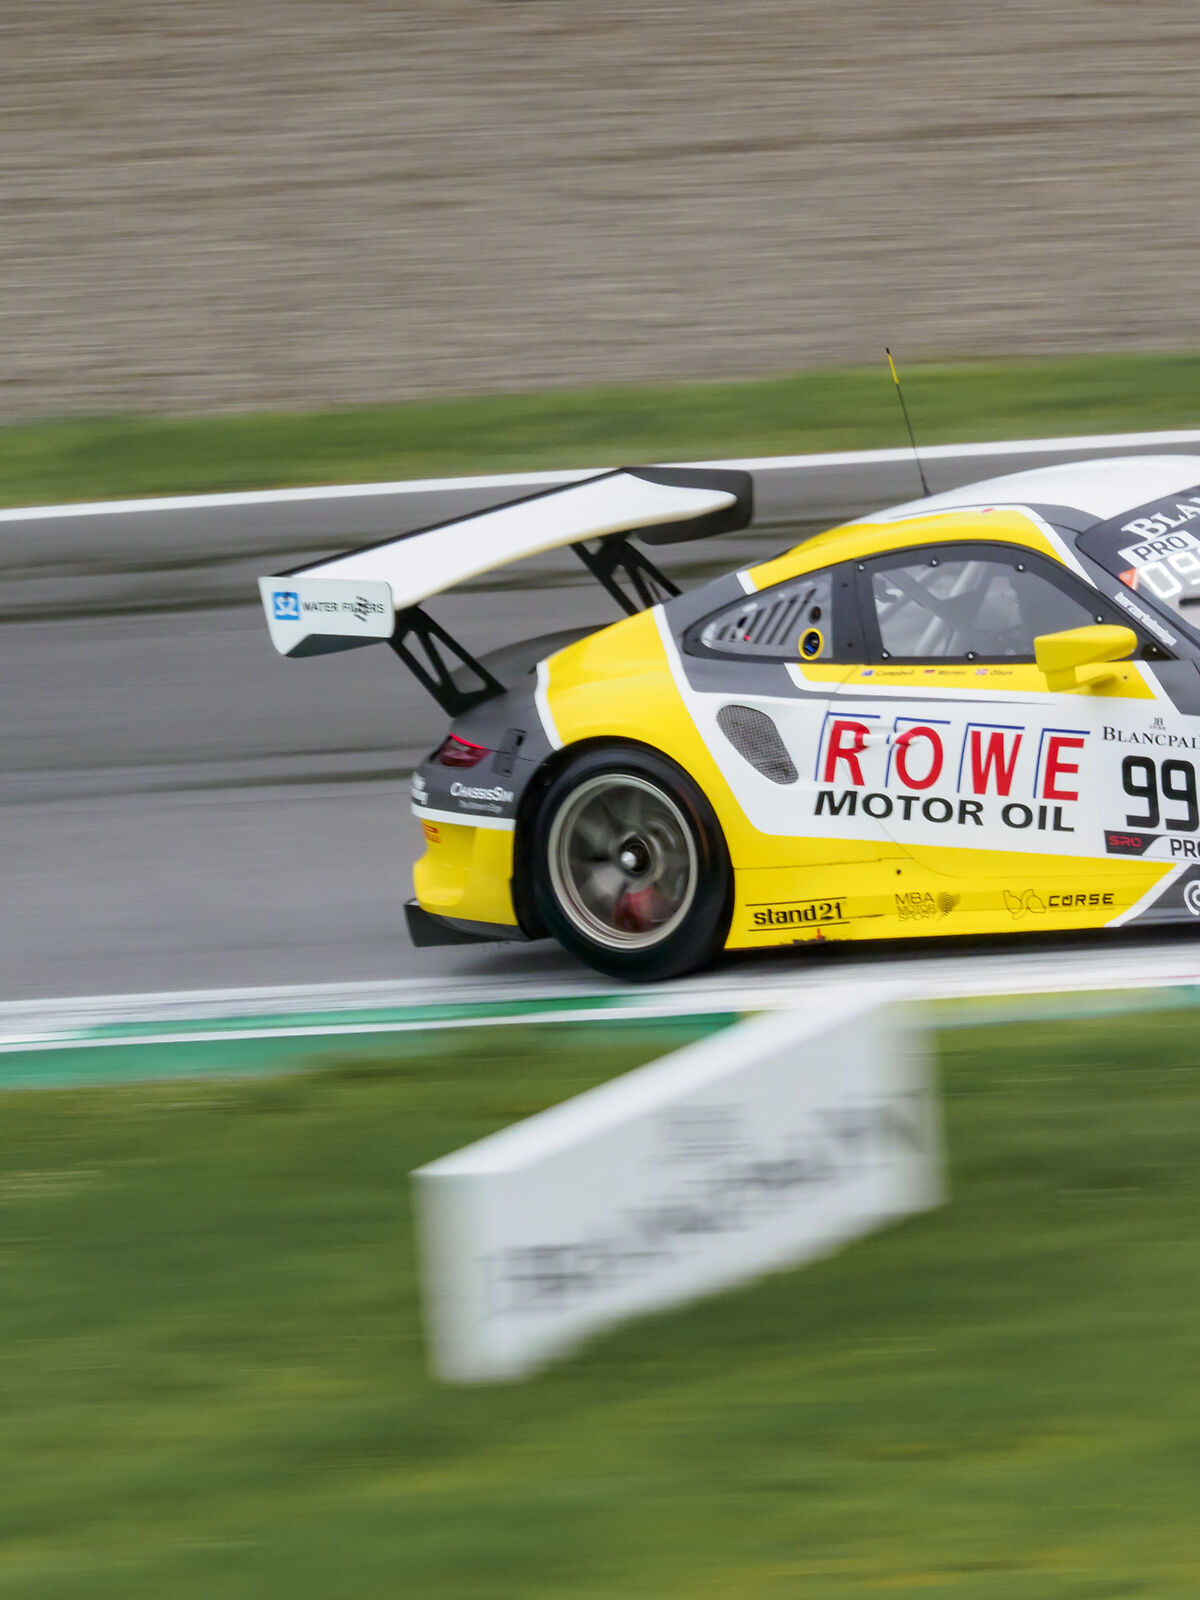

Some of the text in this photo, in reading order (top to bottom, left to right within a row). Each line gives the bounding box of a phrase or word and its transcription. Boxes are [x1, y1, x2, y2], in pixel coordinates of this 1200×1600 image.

[1133, 536, 1189, 562] PRO
[302, 602, 338, 613] WATER
[823, 719, 1085, 801] ROWE
[1121, 755, 1200, 832] 99
[814, 790, 1075, 833] MOTOR OIL
[1108, 835, 1143, 848] SRO
[895, 892, 934, 905] MBA
[1048, 893, 1115, 907] CORSE
